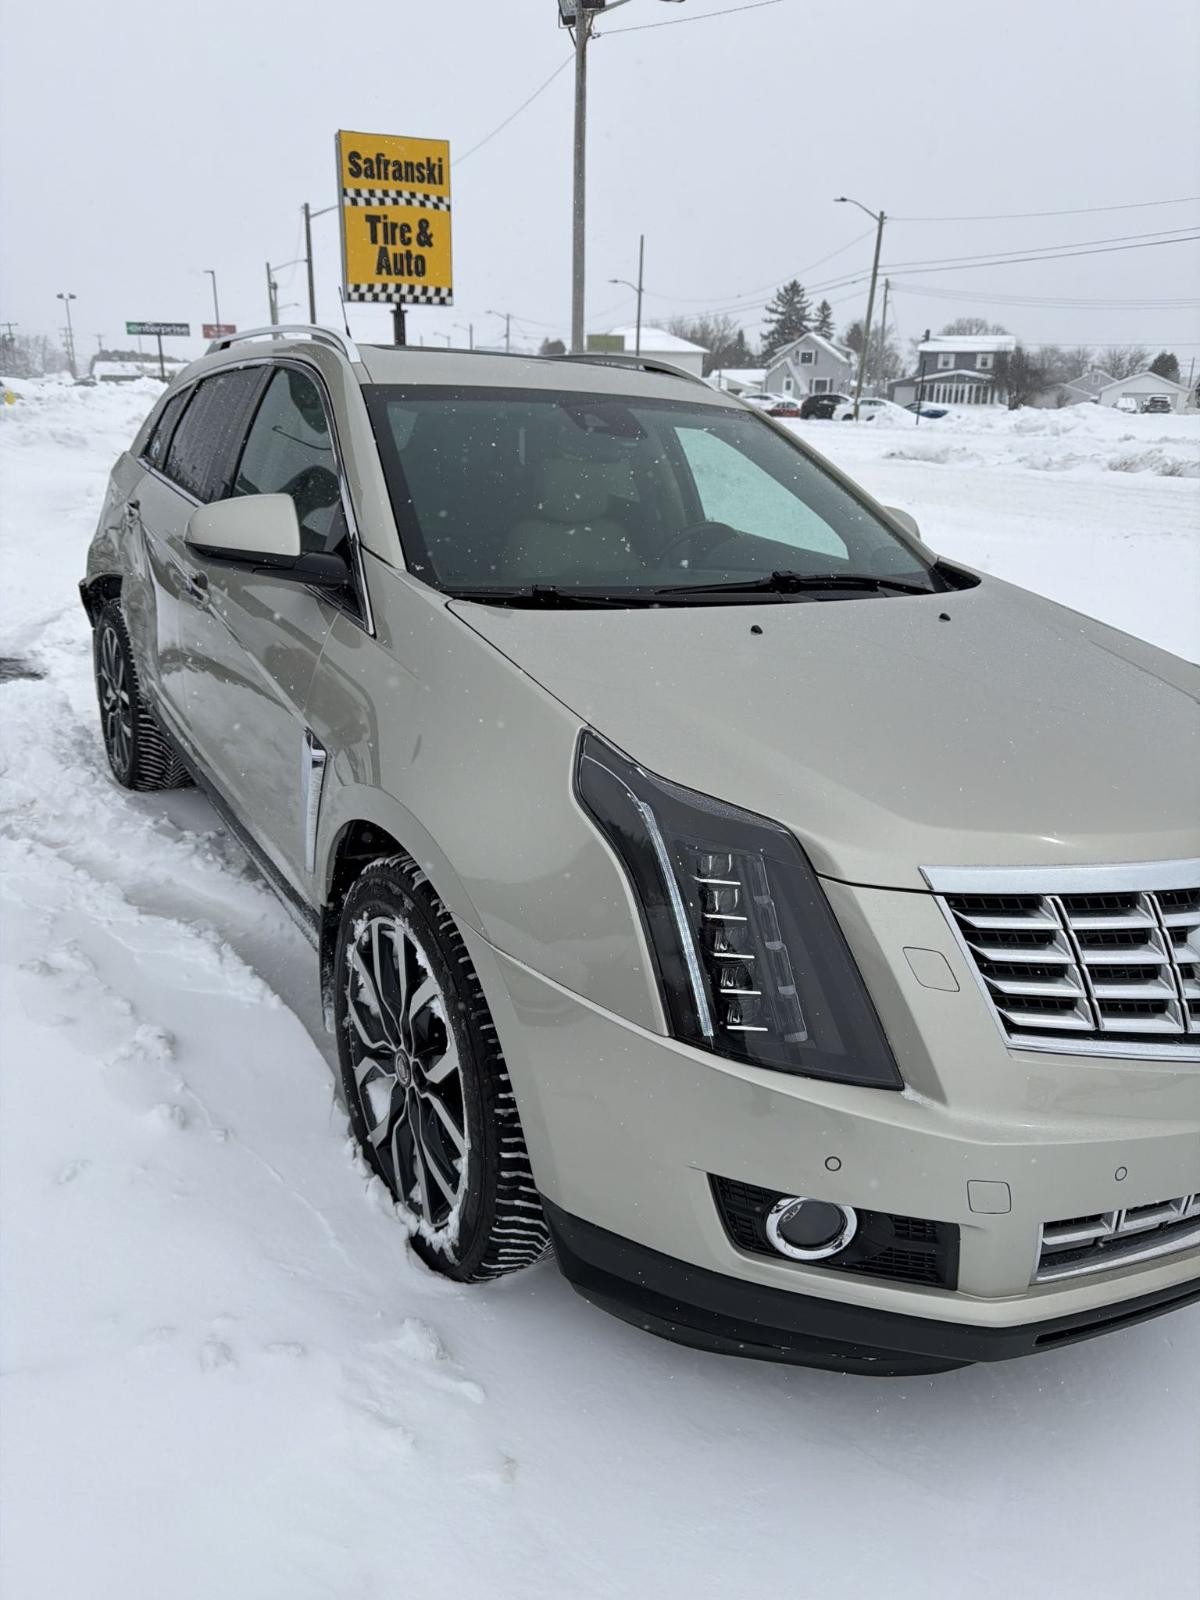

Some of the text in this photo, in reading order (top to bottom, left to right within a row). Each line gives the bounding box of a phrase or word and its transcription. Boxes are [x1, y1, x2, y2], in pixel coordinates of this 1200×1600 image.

[348, 150, 443, 185] Safranski
[365, 214, 433, 247] Tire &
[376, 246, 426, 277] Auto
